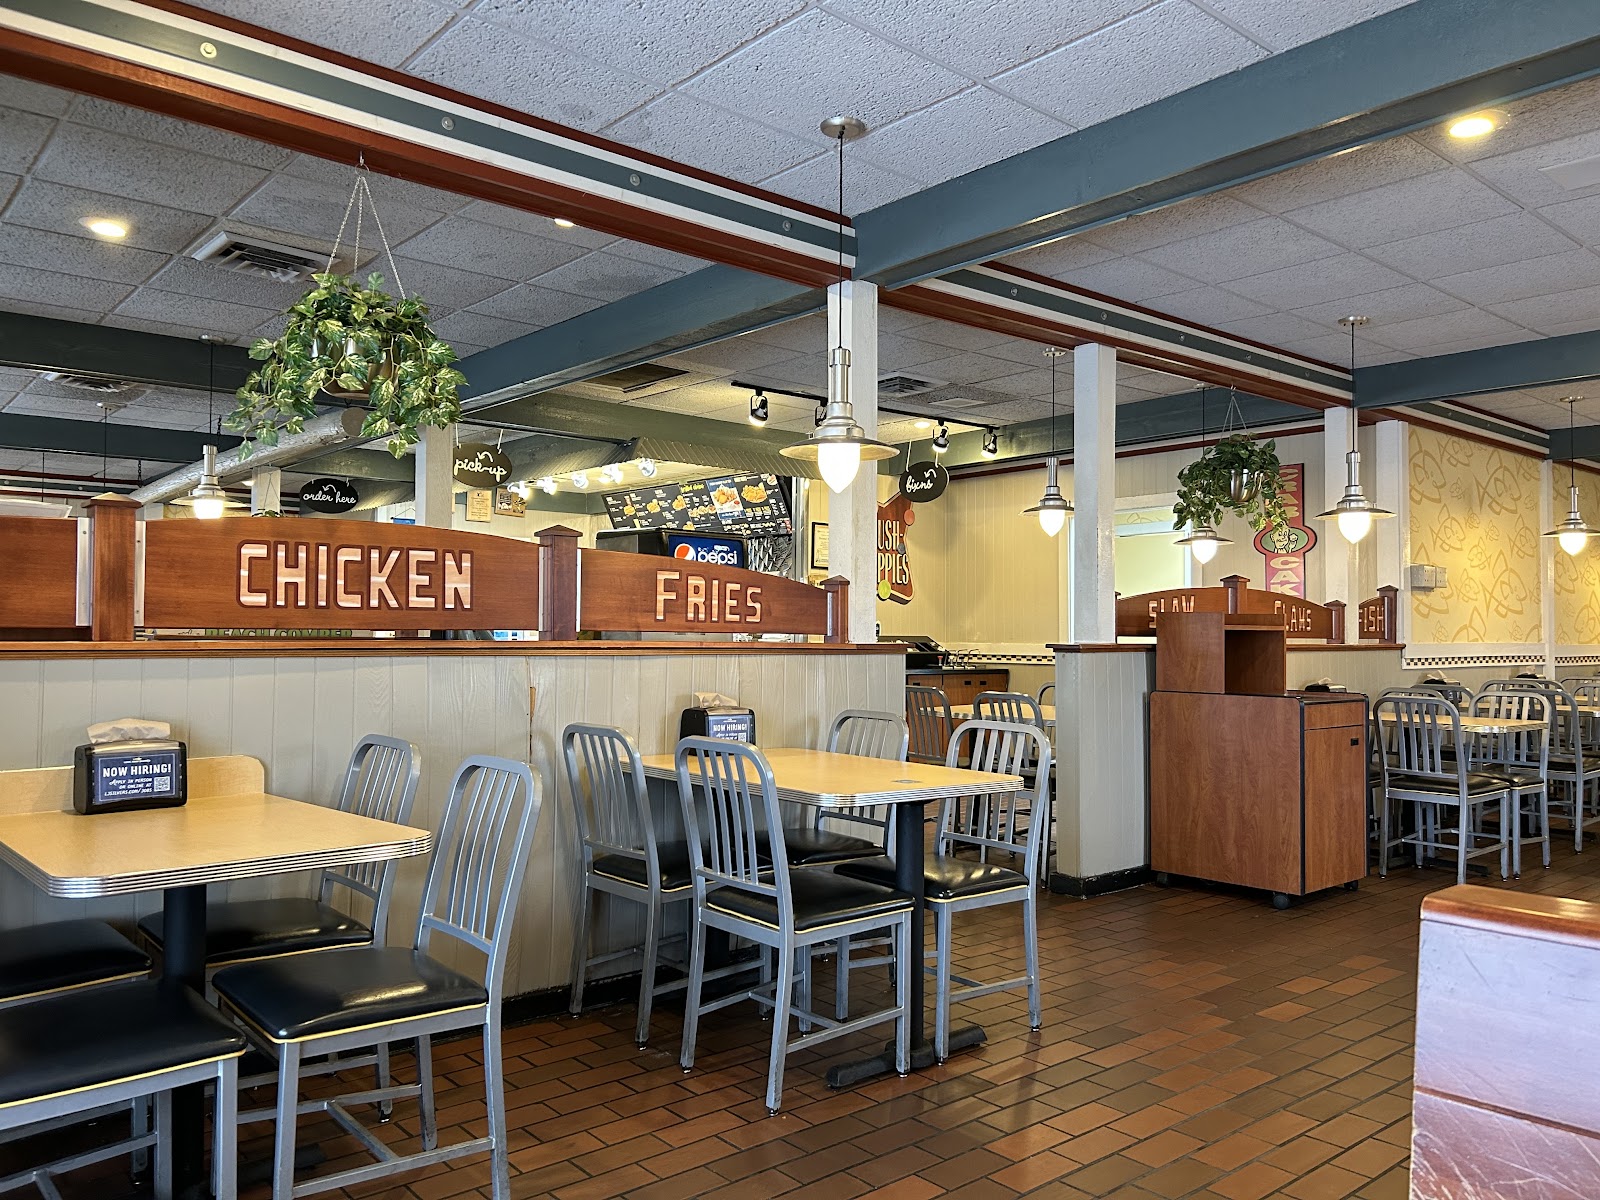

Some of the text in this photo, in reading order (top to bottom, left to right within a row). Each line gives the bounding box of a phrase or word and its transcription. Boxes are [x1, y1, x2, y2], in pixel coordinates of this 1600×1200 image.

[454, 457, 507, 482] pick-up
[303, 486, 357, 504] order here
[877, 519, 904, 550] USH-
[697, 550, 738, 566] pepsi
[877, 552, 909, 585] PPIES
[239, 542, 472, 609] CHICKEN
[1269, 556, 1301, 596] CAK
[656, 570, 762, 623] FRIES
[1359, 605, 1384, 632] ISH
[711, 724, 726, 732] NOW
[102, 763, 172, 778] NOW HIRING!
